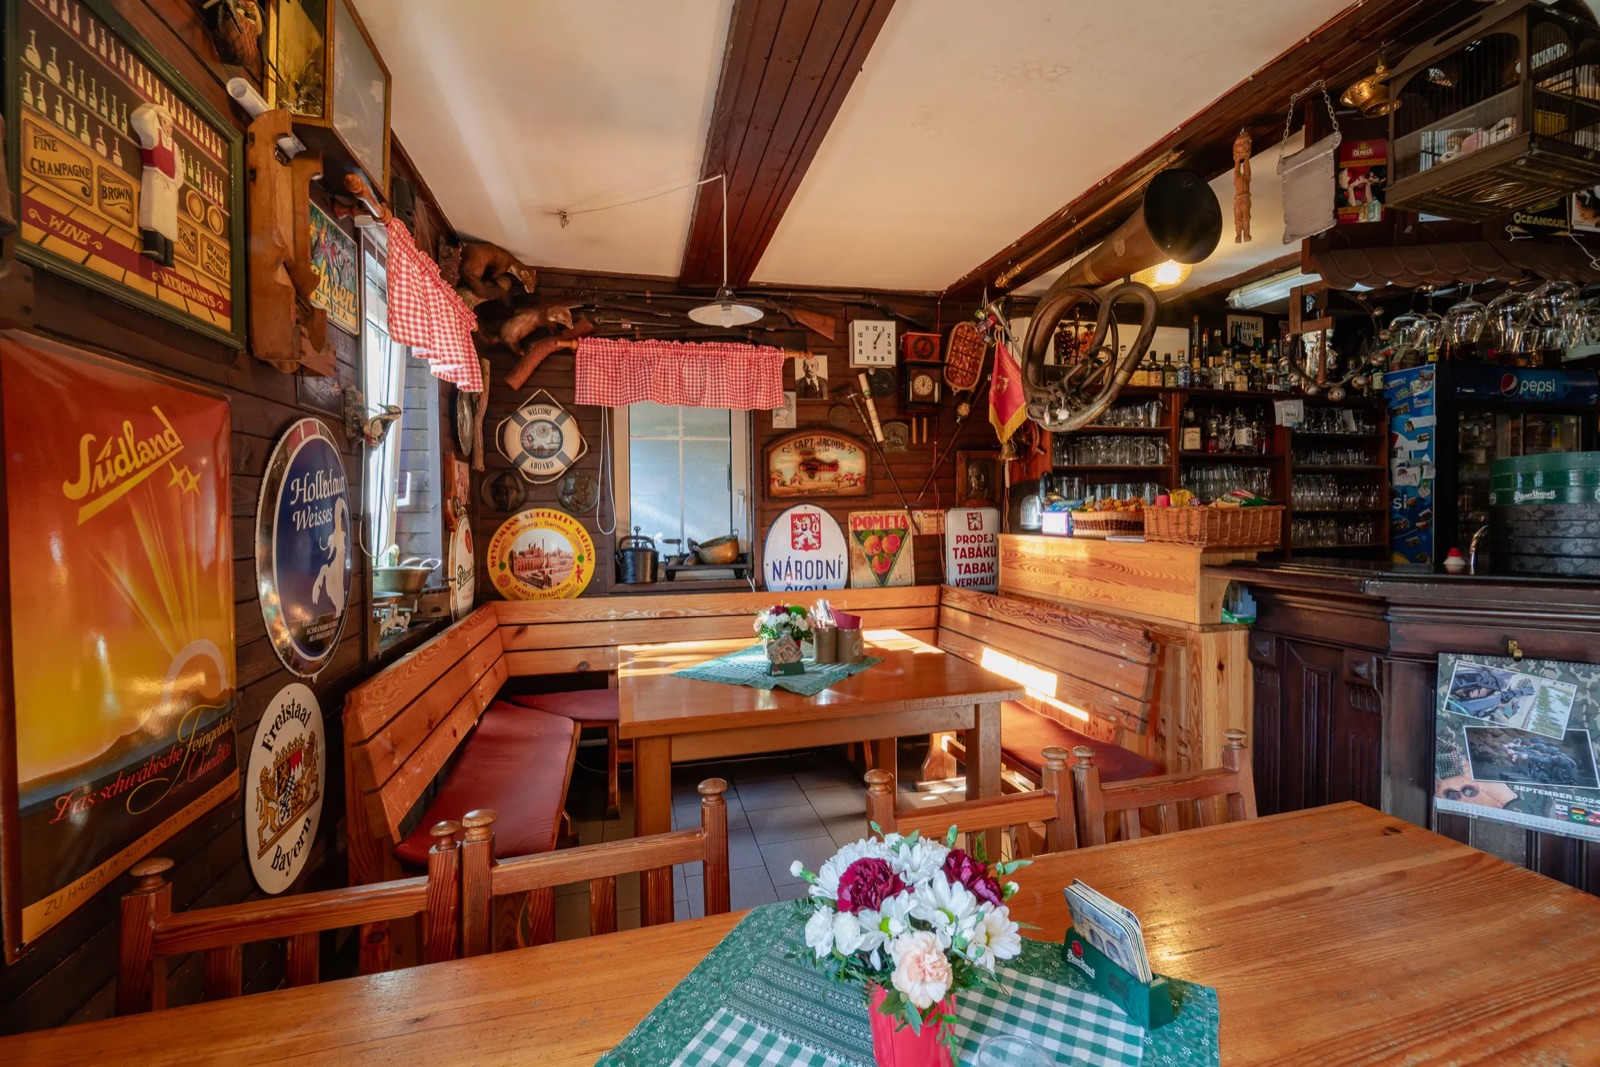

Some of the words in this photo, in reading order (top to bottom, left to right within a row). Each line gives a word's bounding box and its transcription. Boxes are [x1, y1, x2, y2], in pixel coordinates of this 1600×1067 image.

[33, 135, 58, 152] FINE
[31, 158, 92, 180] CHAMPAGNE
[101, 184, 132, 202] BROWN
[48, 214, 91, 246] WINE
[178, 227, 195, 255] SONS
[160, 271, 216, 308] MERCHANTS
[1520, 378, 1556, 395] pepsi
[527, 407, 552, 416] WELCOME
[63, 405, 181, 500] Südland
[816, 437, 846, 450] JACOBS
[529, 461, 555, 470] ABOARD
[293, 506, 332, 531] Weisses
[510, 521, 538, 538] Bamberg
[544, 520, 570, 536] Germany
[955, 533, 994, 545] PRODEJ
[952, 544, 997, 560] TABÁKU
[772, 554, 842, 581] NÁRODNÍ
[957, 561, 995, 575] TABAK
[513, 584, 536, 598] FAMILY
[538, 583, 571, 598] TRADITION
[955, 575, 997, 588] VERKAUF
[261, 698, 312, 754] Freistaat
[1513, 785, 1573, 800] SEPTEMBER
[50, 787, 96, 824] Das
[270, 815, 312, 877] Bayern
[44, 897, 63, 916] ZU
[67, 866, 106, 897] HABEN
[108, 859, 119, 873] IN
